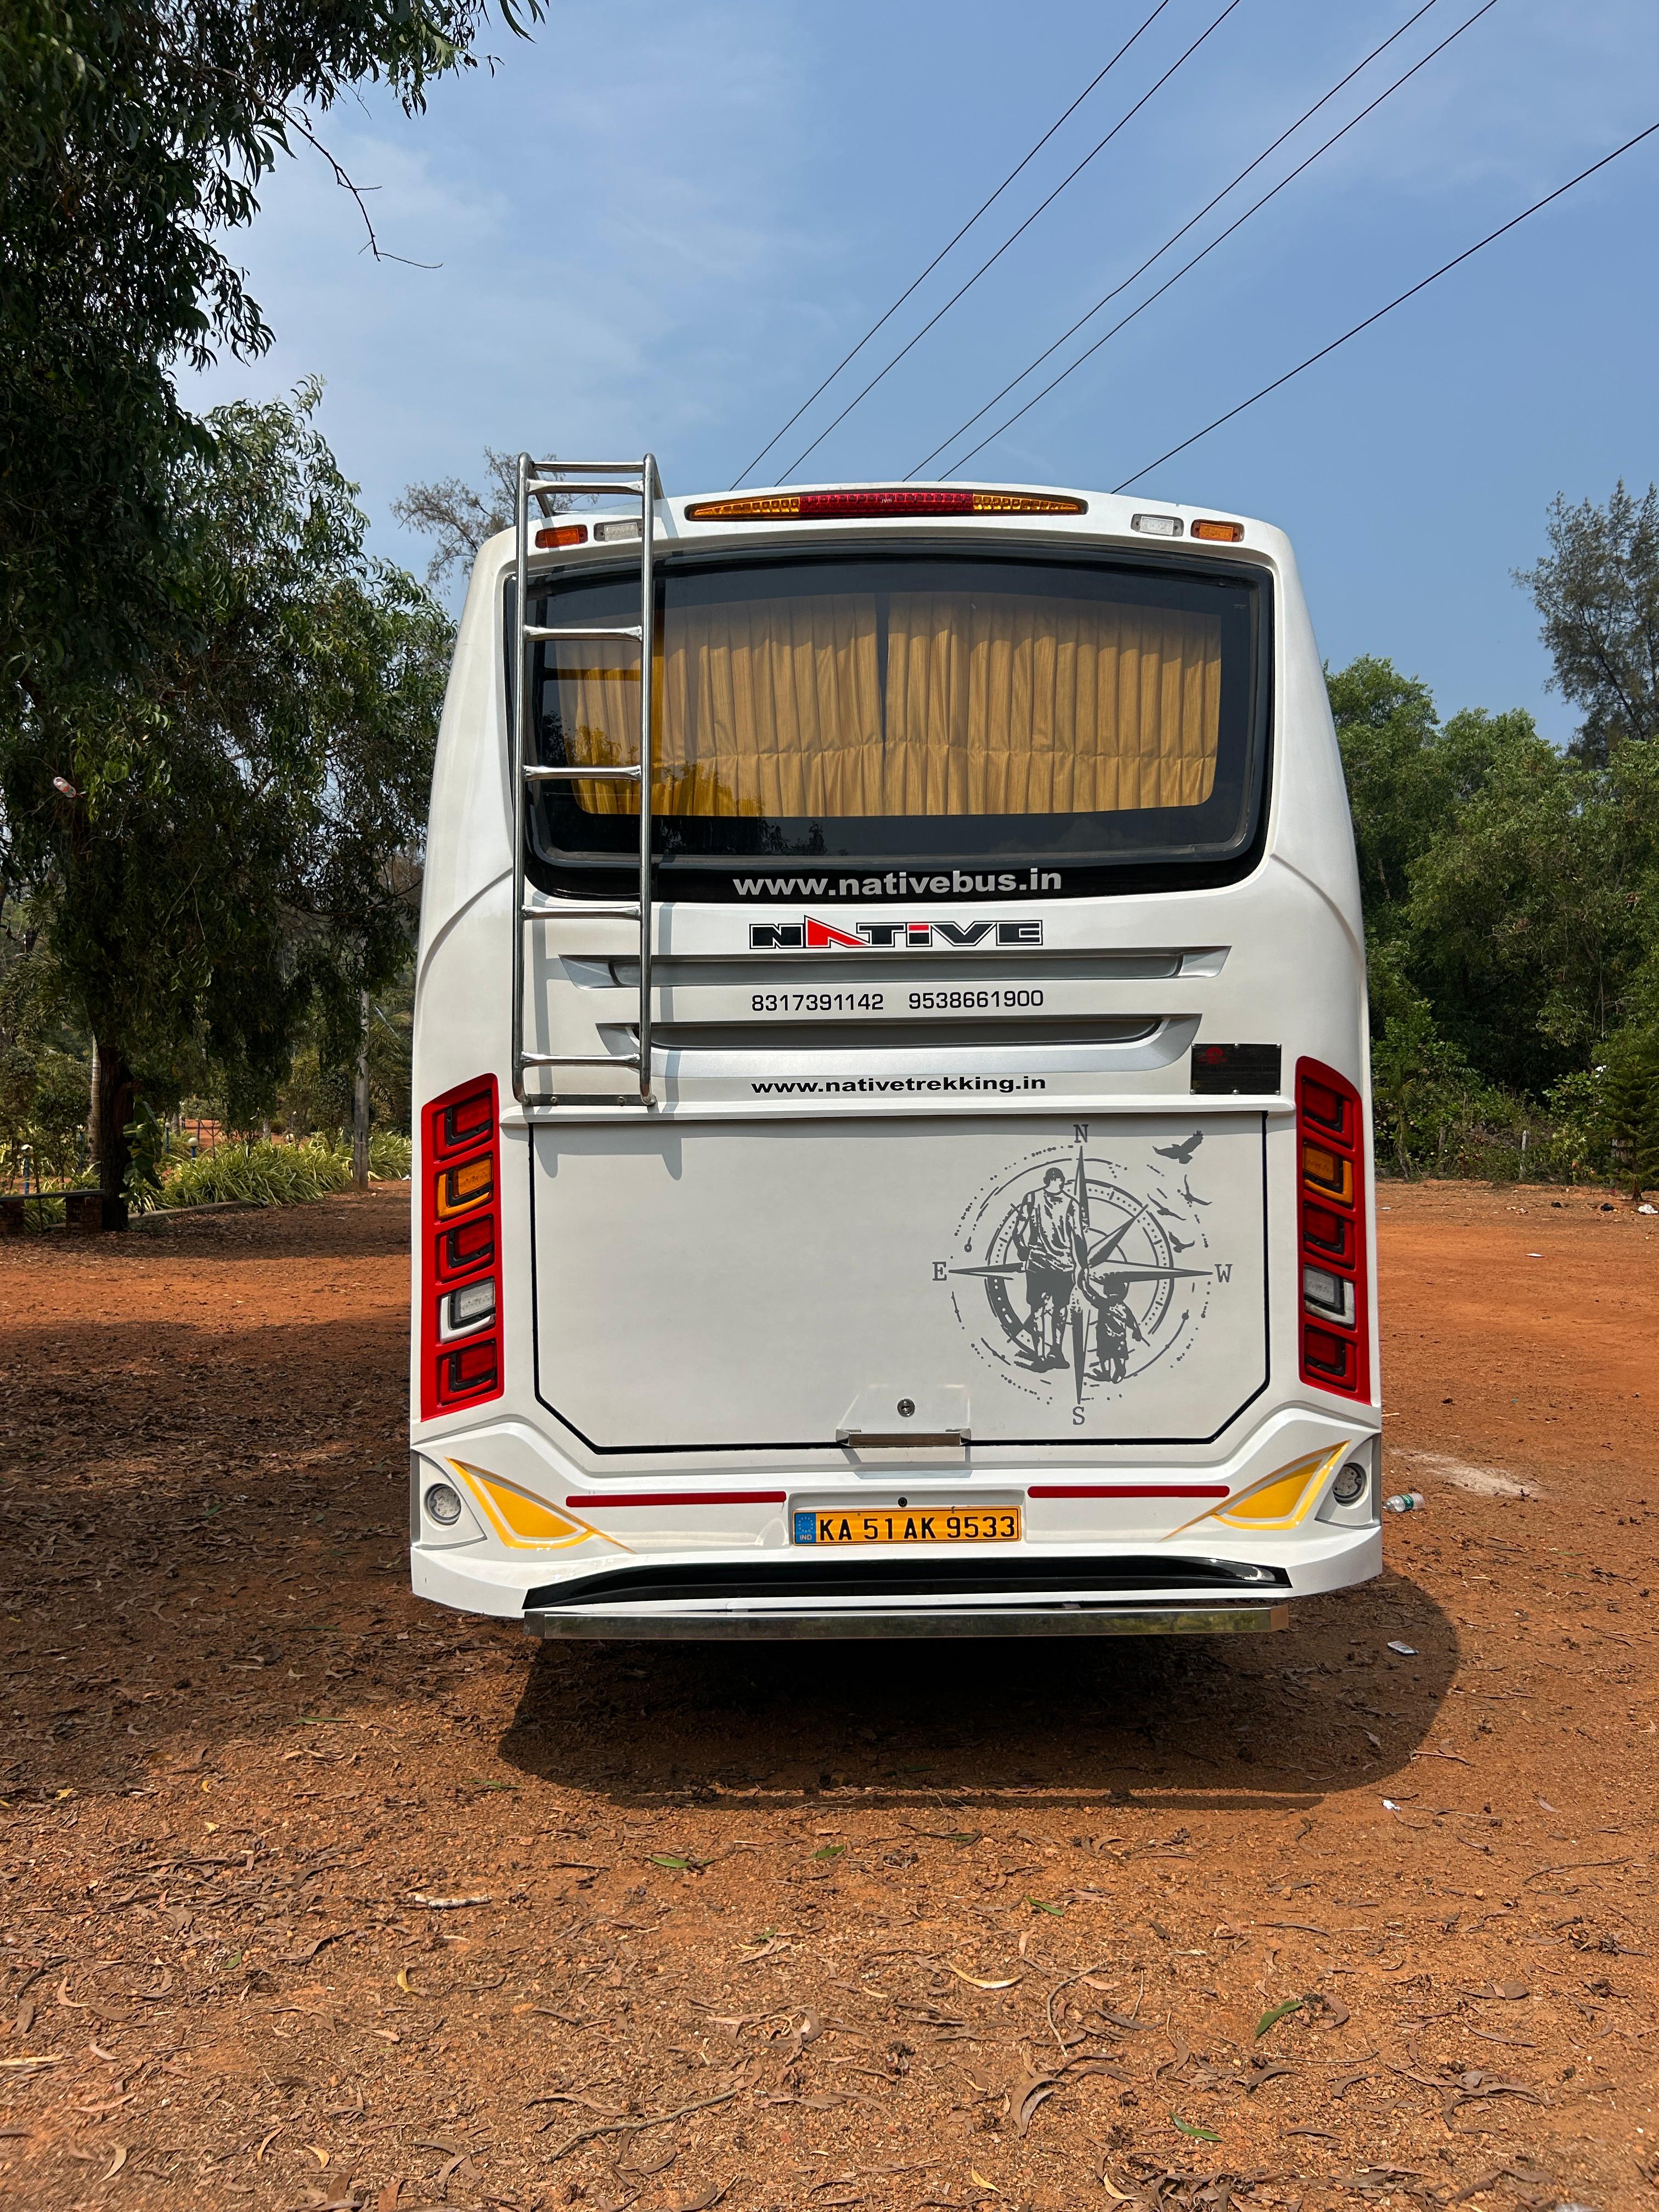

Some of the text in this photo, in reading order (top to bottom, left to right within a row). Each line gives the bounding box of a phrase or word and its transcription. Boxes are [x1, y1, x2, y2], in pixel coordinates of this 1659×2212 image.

[733, 868, 1062, 895] www.nativebus.in
[752, 990, 1043, 1011] 8317391142 9538661900
[751, 1076, 1045, 1093] www.nativetrekking.in
[1073, 1124, 1088, 1143] N
[932, 1261, 947, 1281] E
[1215, 1263, 1233, 1283] W
[1073, 1407, 1085, 1425] S
[820, 1516, 1015, 1541] KA 51 AK 9533
